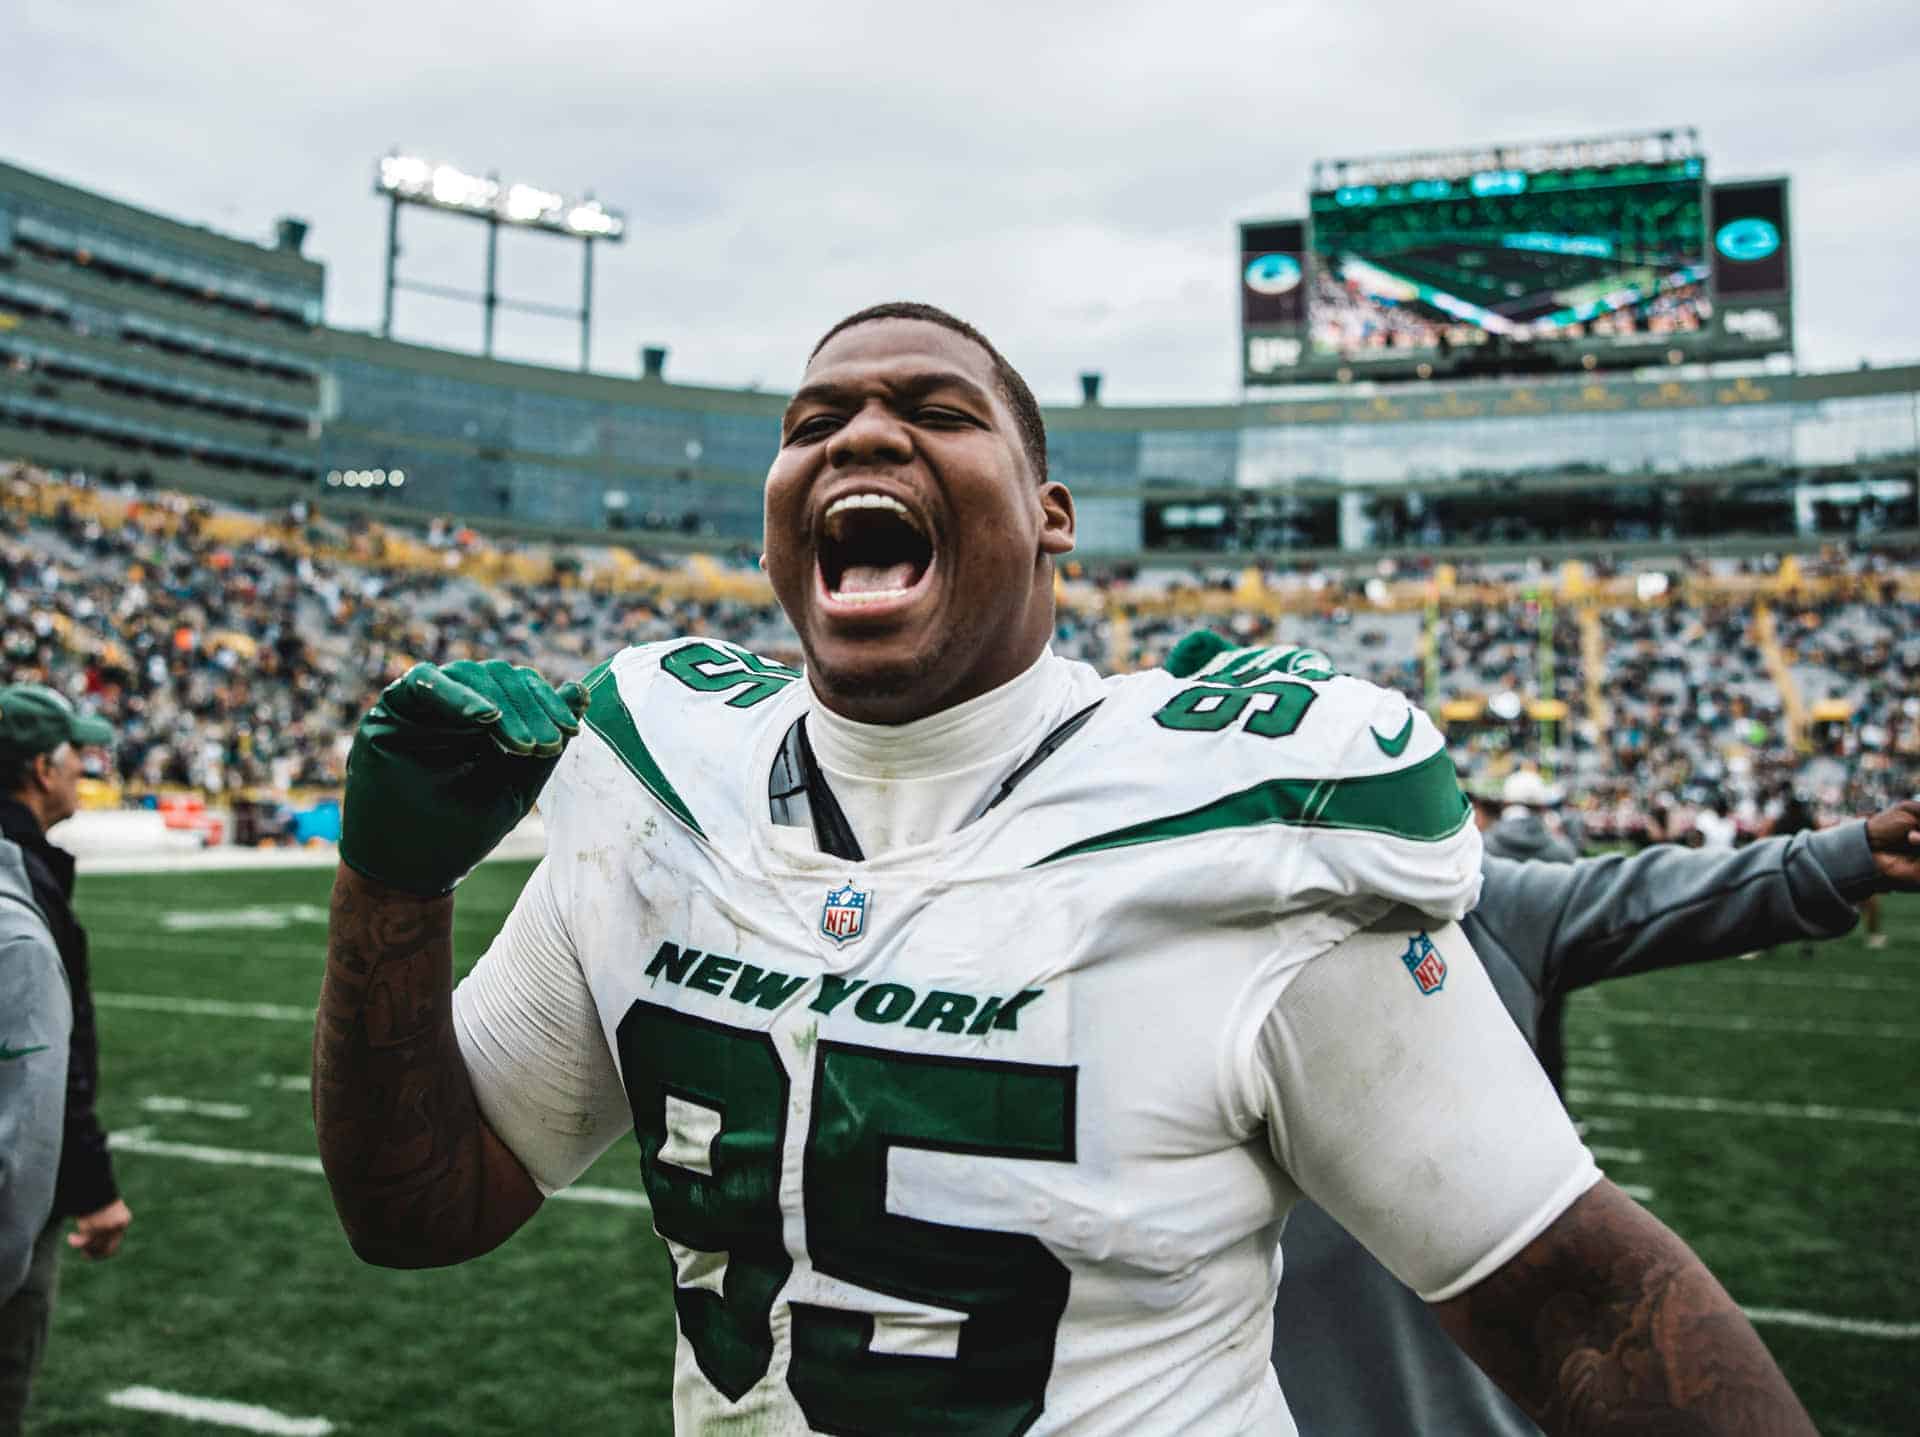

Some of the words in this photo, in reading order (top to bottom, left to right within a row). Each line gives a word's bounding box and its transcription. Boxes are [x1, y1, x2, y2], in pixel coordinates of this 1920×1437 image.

[825, 908, 858, 937] NFL
[645, 941, 808, 1011] NEW
[807, 973, 1045, 1037] YORK
[1415, 952, 1444, 991] NFL
[616, 998, 1079, 1437] 95
